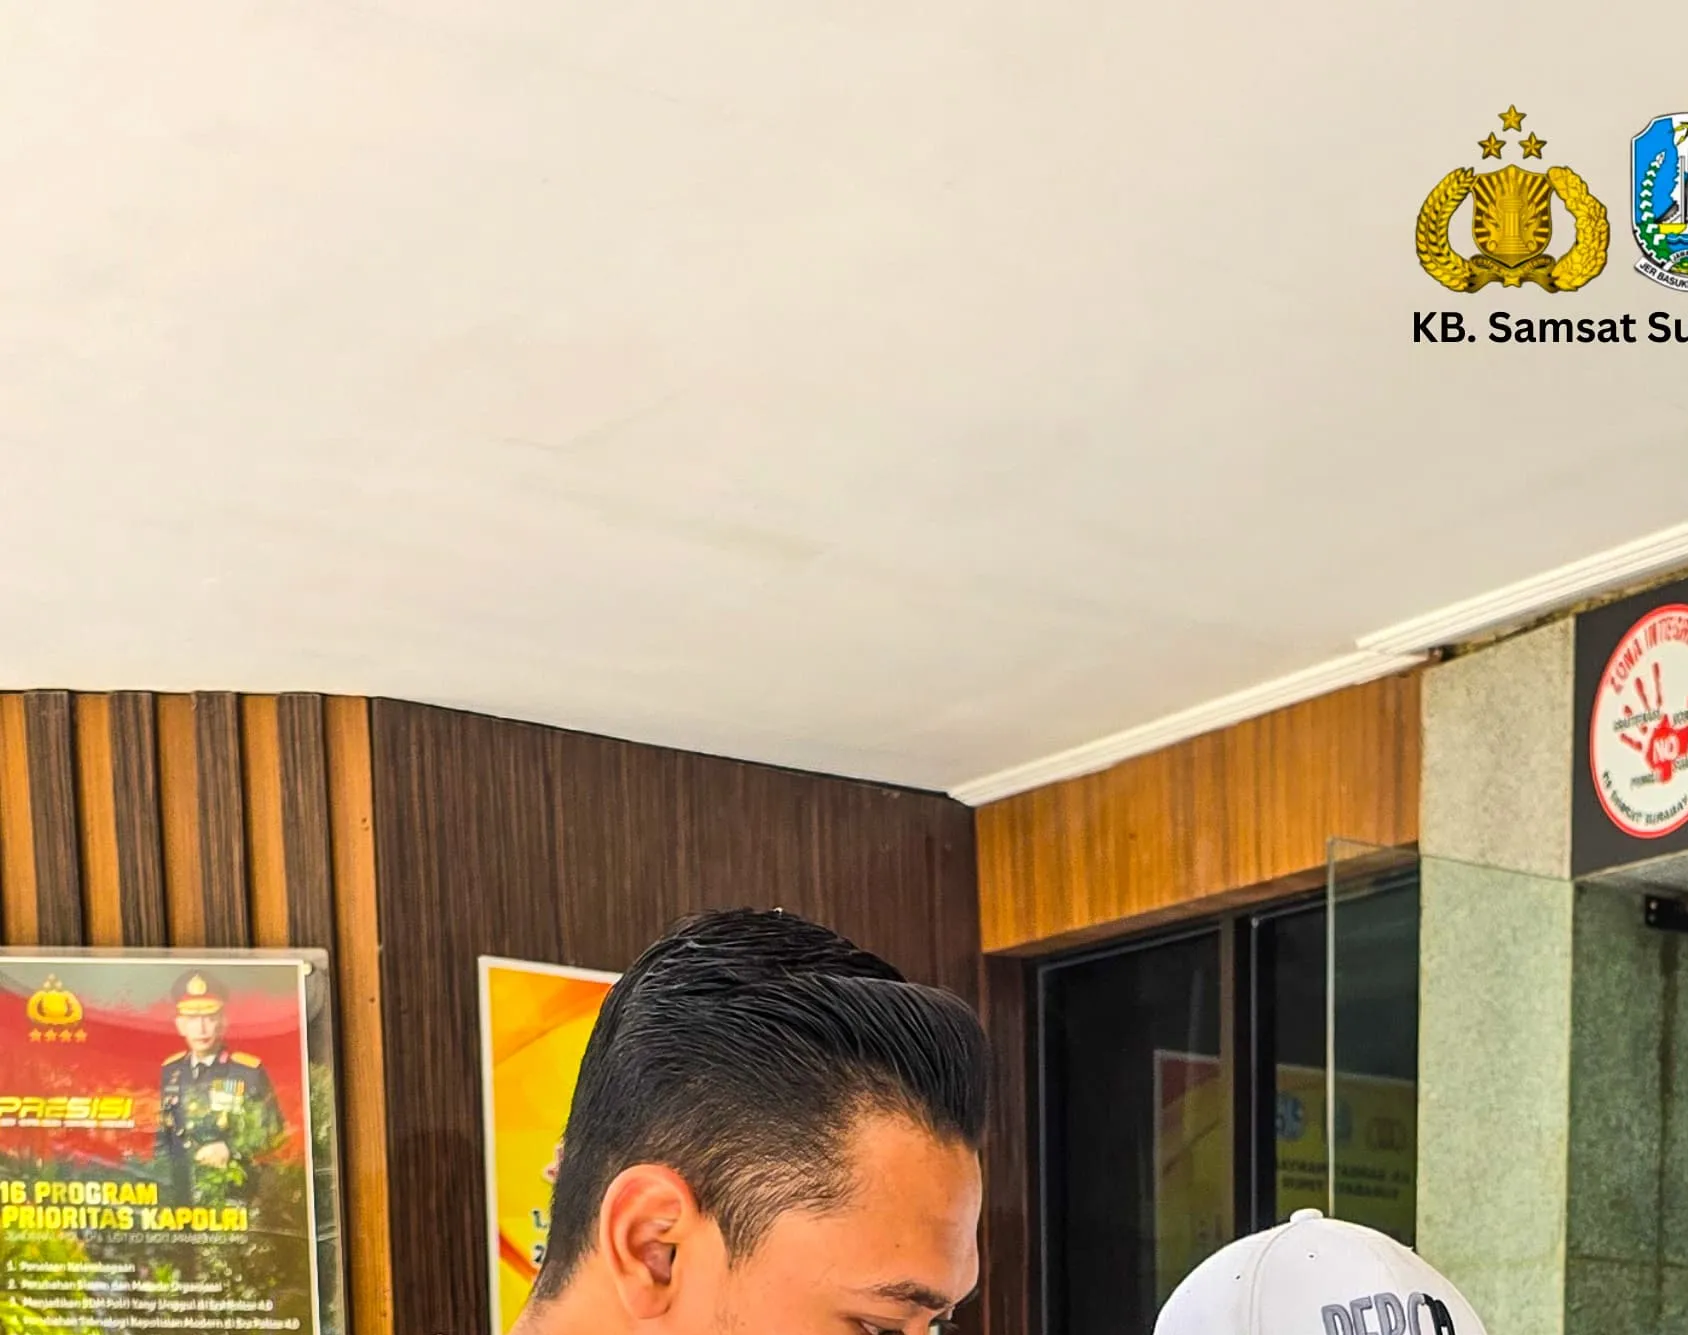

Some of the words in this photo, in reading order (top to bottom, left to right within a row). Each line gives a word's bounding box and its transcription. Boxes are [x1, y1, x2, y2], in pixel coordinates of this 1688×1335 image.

[1651, 734, 1680, 765] NO
[0, 1181, 26, 1205] 16
[34, 1181, 158, 1205] PROGRAM
[1, 1205, 134, 1230] PRIORITAS
[141, 1207, 249, 1232] KAPOLRI
